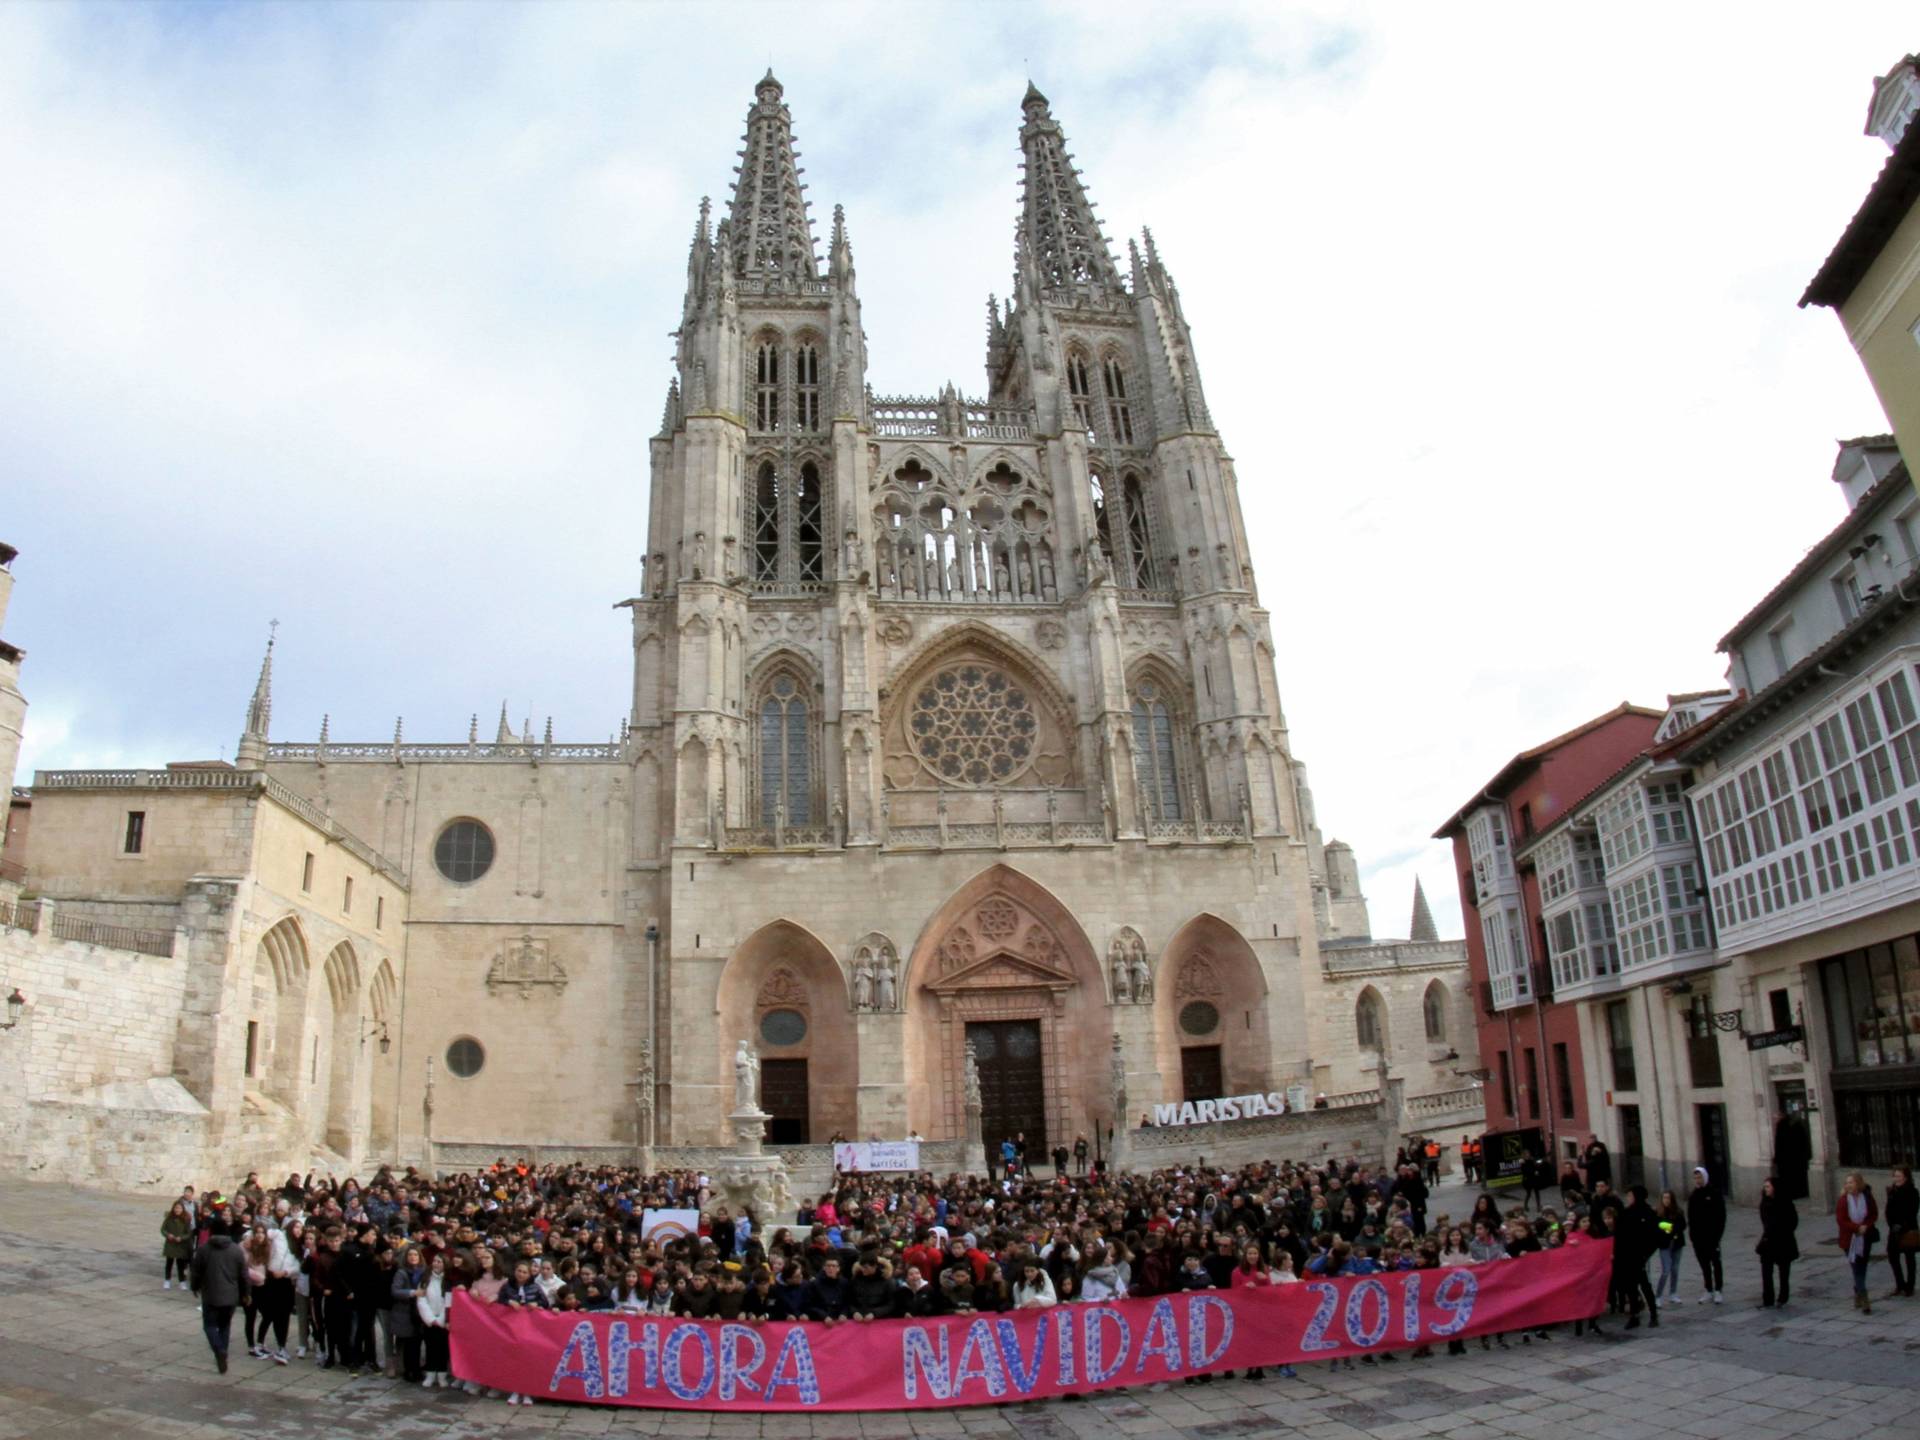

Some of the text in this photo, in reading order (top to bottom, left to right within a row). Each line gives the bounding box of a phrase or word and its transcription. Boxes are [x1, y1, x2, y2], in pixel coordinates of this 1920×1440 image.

[1152, 1092, 1285, 1127] MARISTAS
[549, 1268, 1479, 1405] AHORA NAVIDAD 2019
